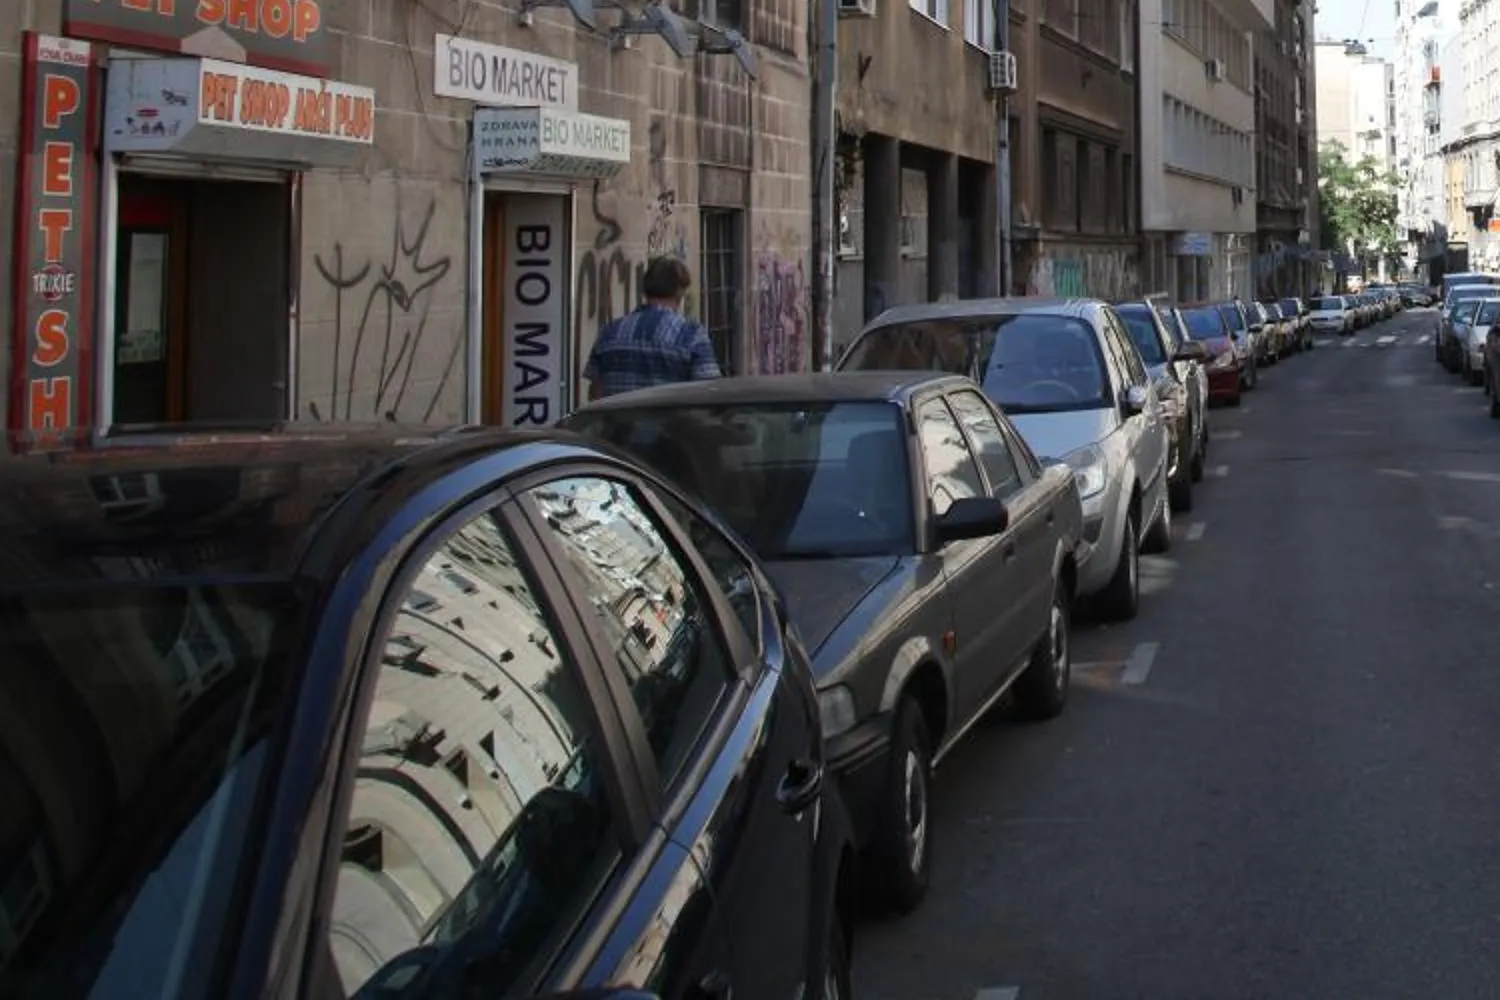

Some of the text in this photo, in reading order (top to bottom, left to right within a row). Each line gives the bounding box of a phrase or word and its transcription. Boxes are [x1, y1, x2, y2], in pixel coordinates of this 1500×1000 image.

[201, 71, 238, 122] PET
[239, 77, 290, 129] SHOP
[448, 47, 569, 105] BIO MARKET
[543, 117, 627, 153] BIO MARKET
[38, 73, 81, 263] PET
[32, 269, 75, 294] TRIXIE
[515, 224, 551, 306] BIO
[29, 309, 70, 443] SH
